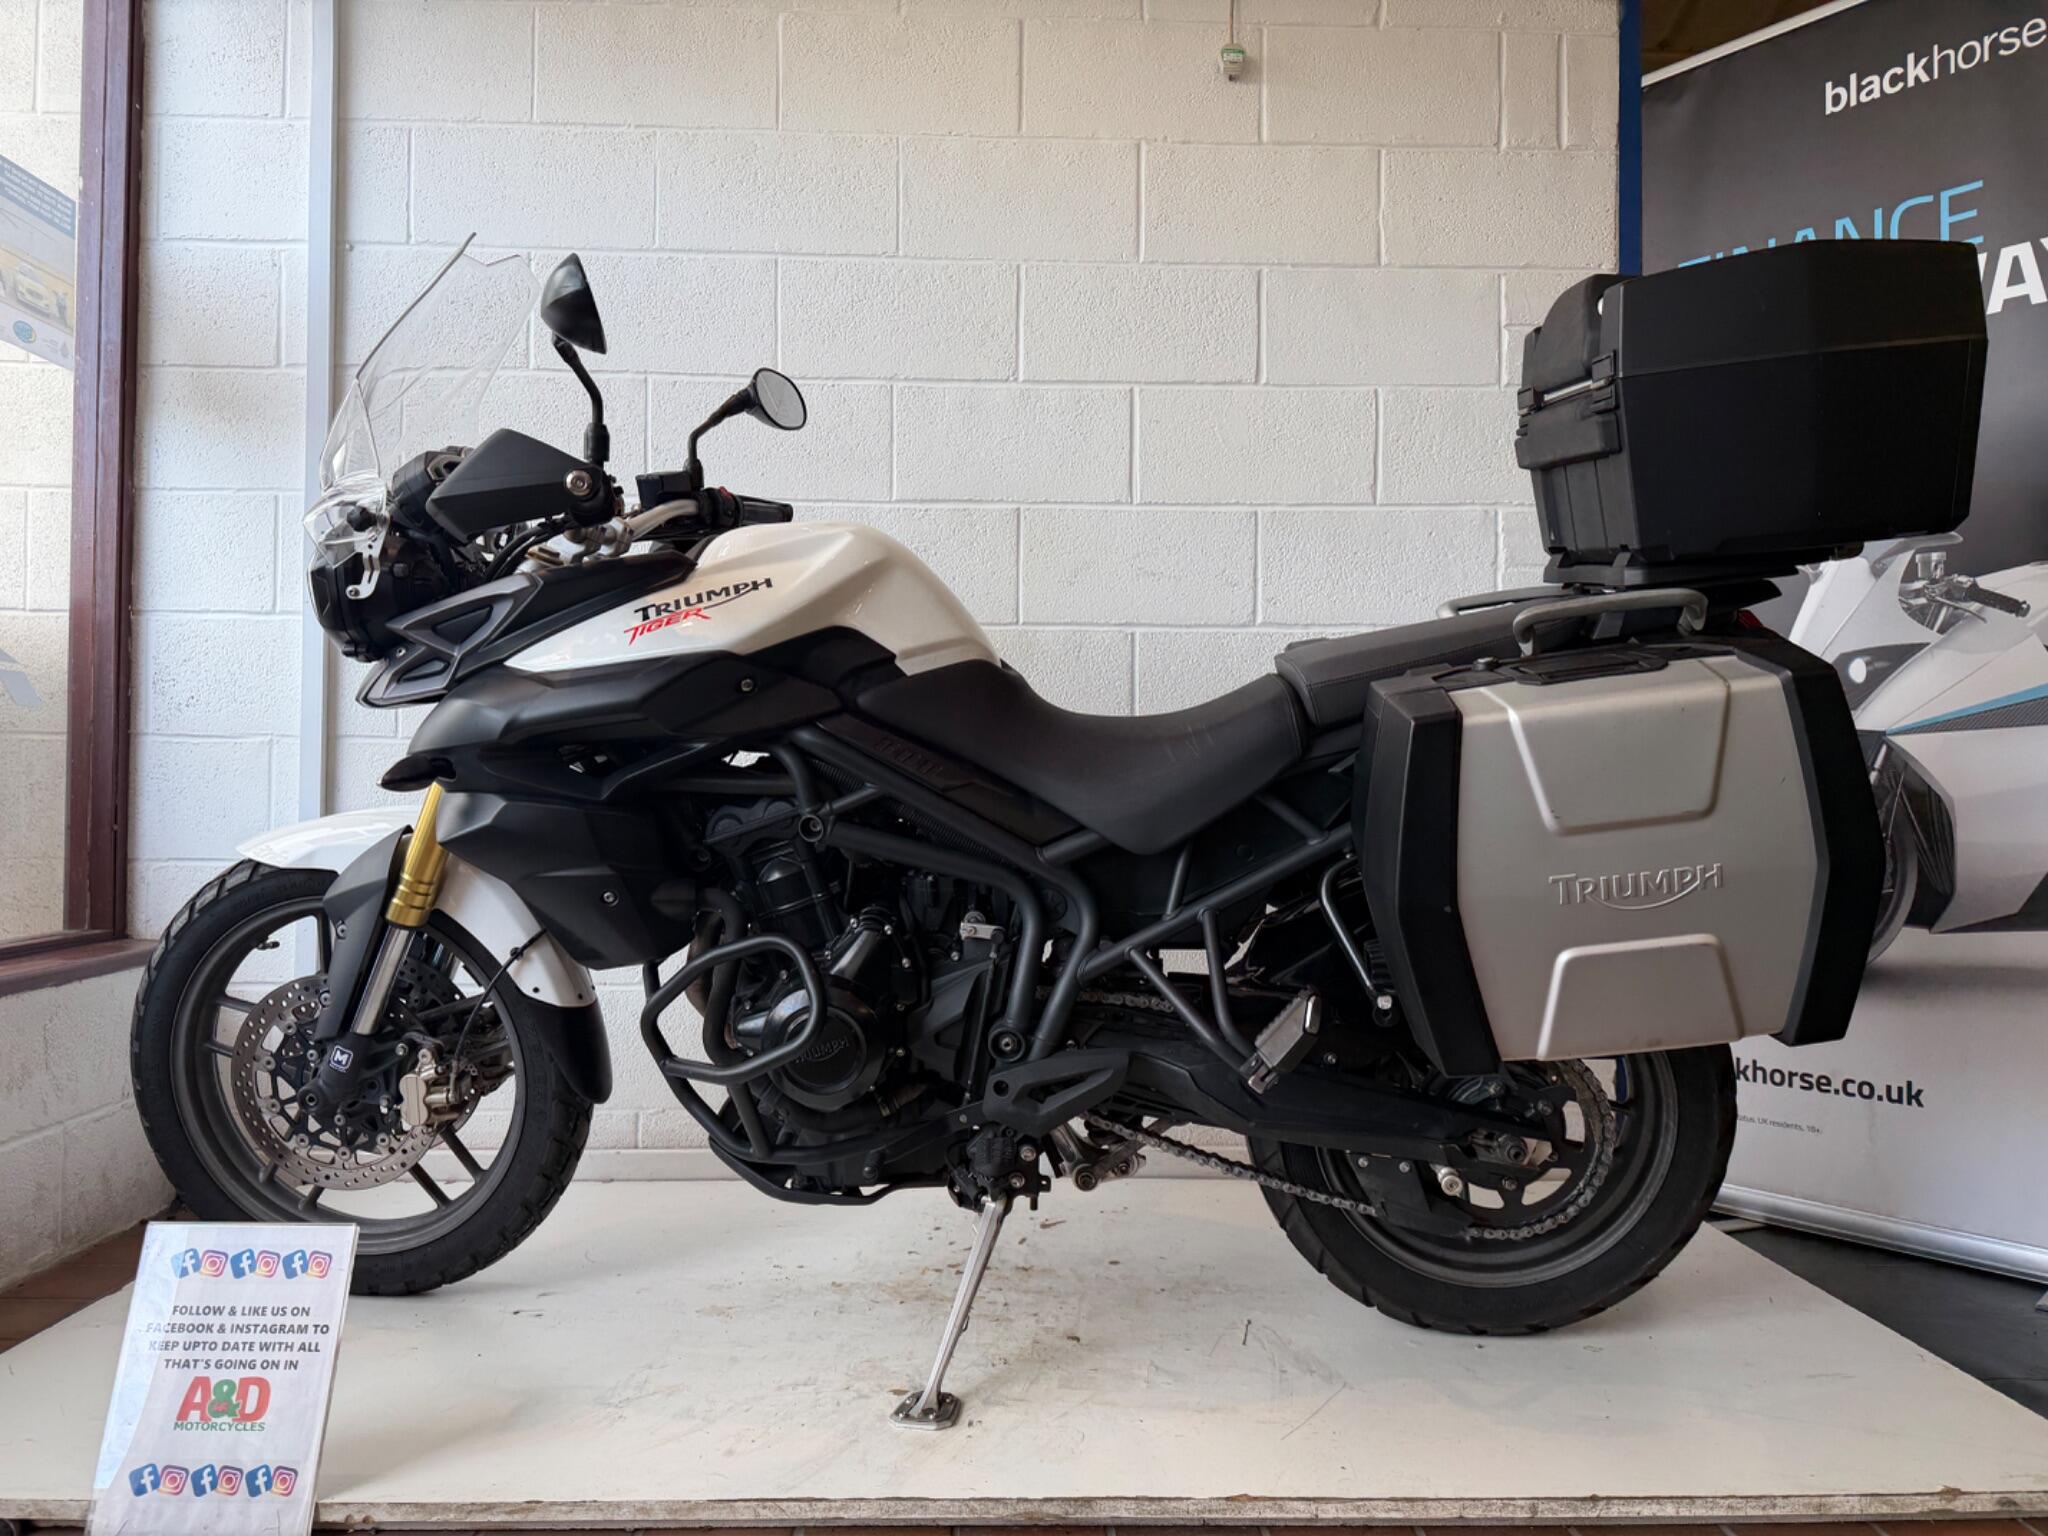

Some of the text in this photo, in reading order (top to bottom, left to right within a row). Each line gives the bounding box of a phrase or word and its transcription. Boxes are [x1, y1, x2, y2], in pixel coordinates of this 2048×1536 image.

[1824, 17, 2047, 115] blackhorse
[634, 577, 774, 622] TRIUMPH
[623, 607, 712, 646] TIGER
[1549, 862, 1724, 908] TRIUMPH
[172, 1305, 311, 1317] FOLLOW & LIKE US ON
[146, 1322, 330, 1335] FACEBOOK & INSTAGRAM TO
[149, 1340, 321, 1353] KEEP UPTO DATE WITH ALL
[164, 1358, 299, 1370] THAT'S GOING ON IN
[175, 1376, 271, 1422] A&D
[173, 1421, 266, 1432] MOTORCYCLES
